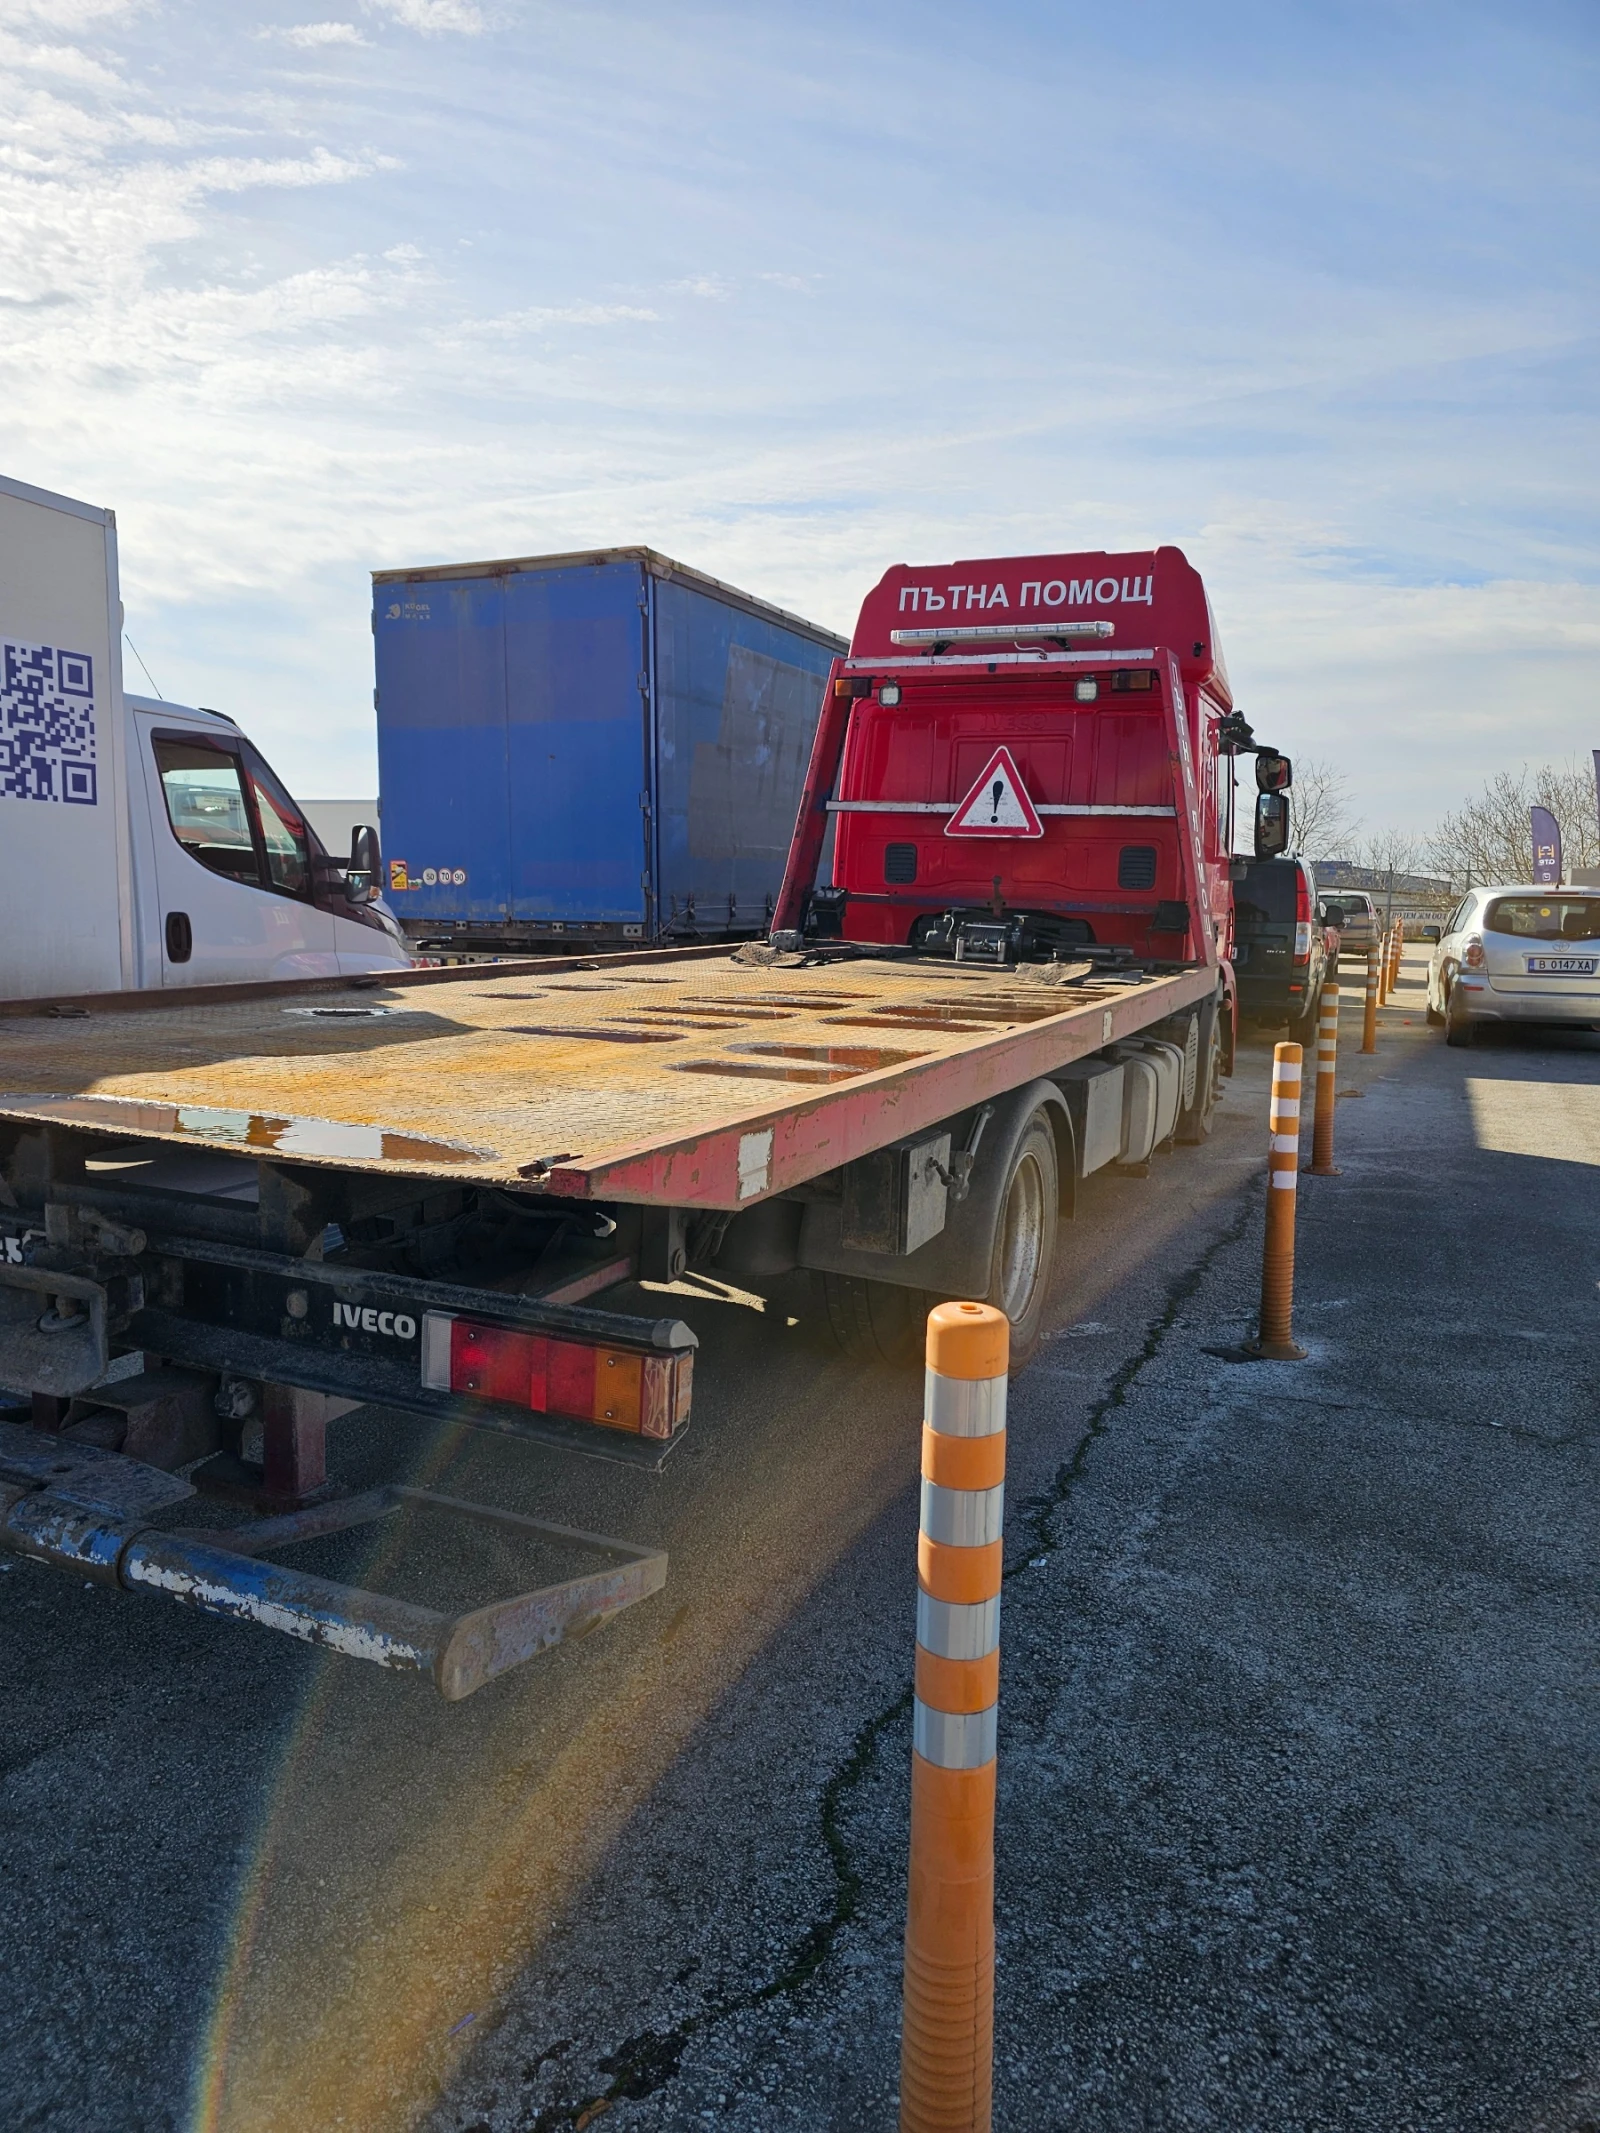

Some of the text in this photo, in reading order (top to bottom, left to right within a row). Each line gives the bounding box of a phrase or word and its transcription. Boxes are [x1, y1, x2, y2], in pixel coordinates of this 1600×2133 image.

[899, 575, 1153, 612] ПЪТНА ПОМОЩ
[426, 873, 435, 881] 50
[441, 872, 450, 881] 70
[455, 873, 464, 881] 90
[1539, 960, 1546, 970] B
[1551, 960, 1576, 970] 0147
[1577, 960, 1591, 970] XA
[333, 1302, 416, 1340] IVECO
